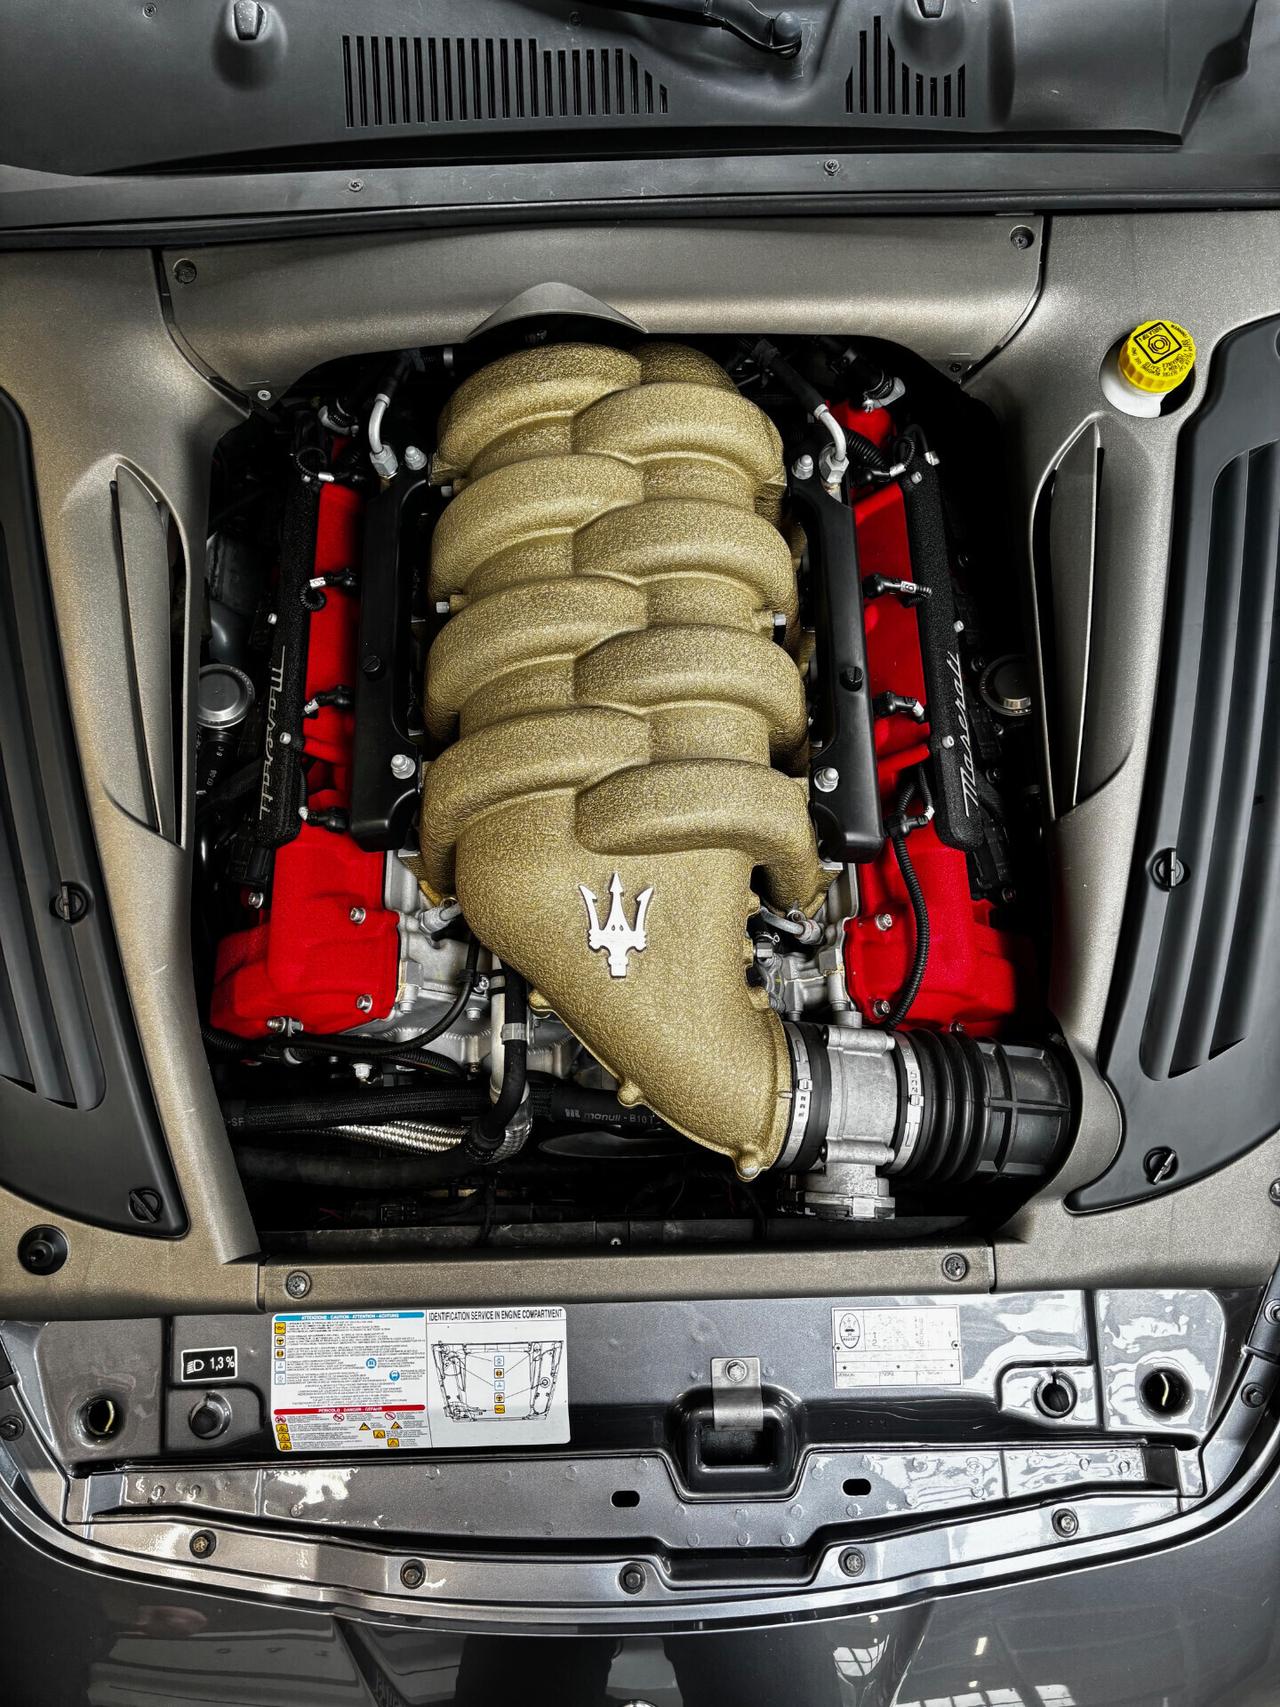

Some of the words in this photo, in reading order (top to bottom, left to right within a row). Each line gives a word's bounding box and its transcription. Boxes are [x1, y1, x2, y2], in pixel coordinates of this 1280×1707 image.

[259, 645, 286, 821] Maserati
[946, 651, 979, 818] Maserati
[428, 1311, 470, 1321] IDENTIFICATION
[471, 1310, 494, 1320] SERVICE
[494, 1310, 500, 1320] IN
[501, 1309, 521, 1319] ENGINE
[522, 1308, 563, 1319] COMPARTMENT
